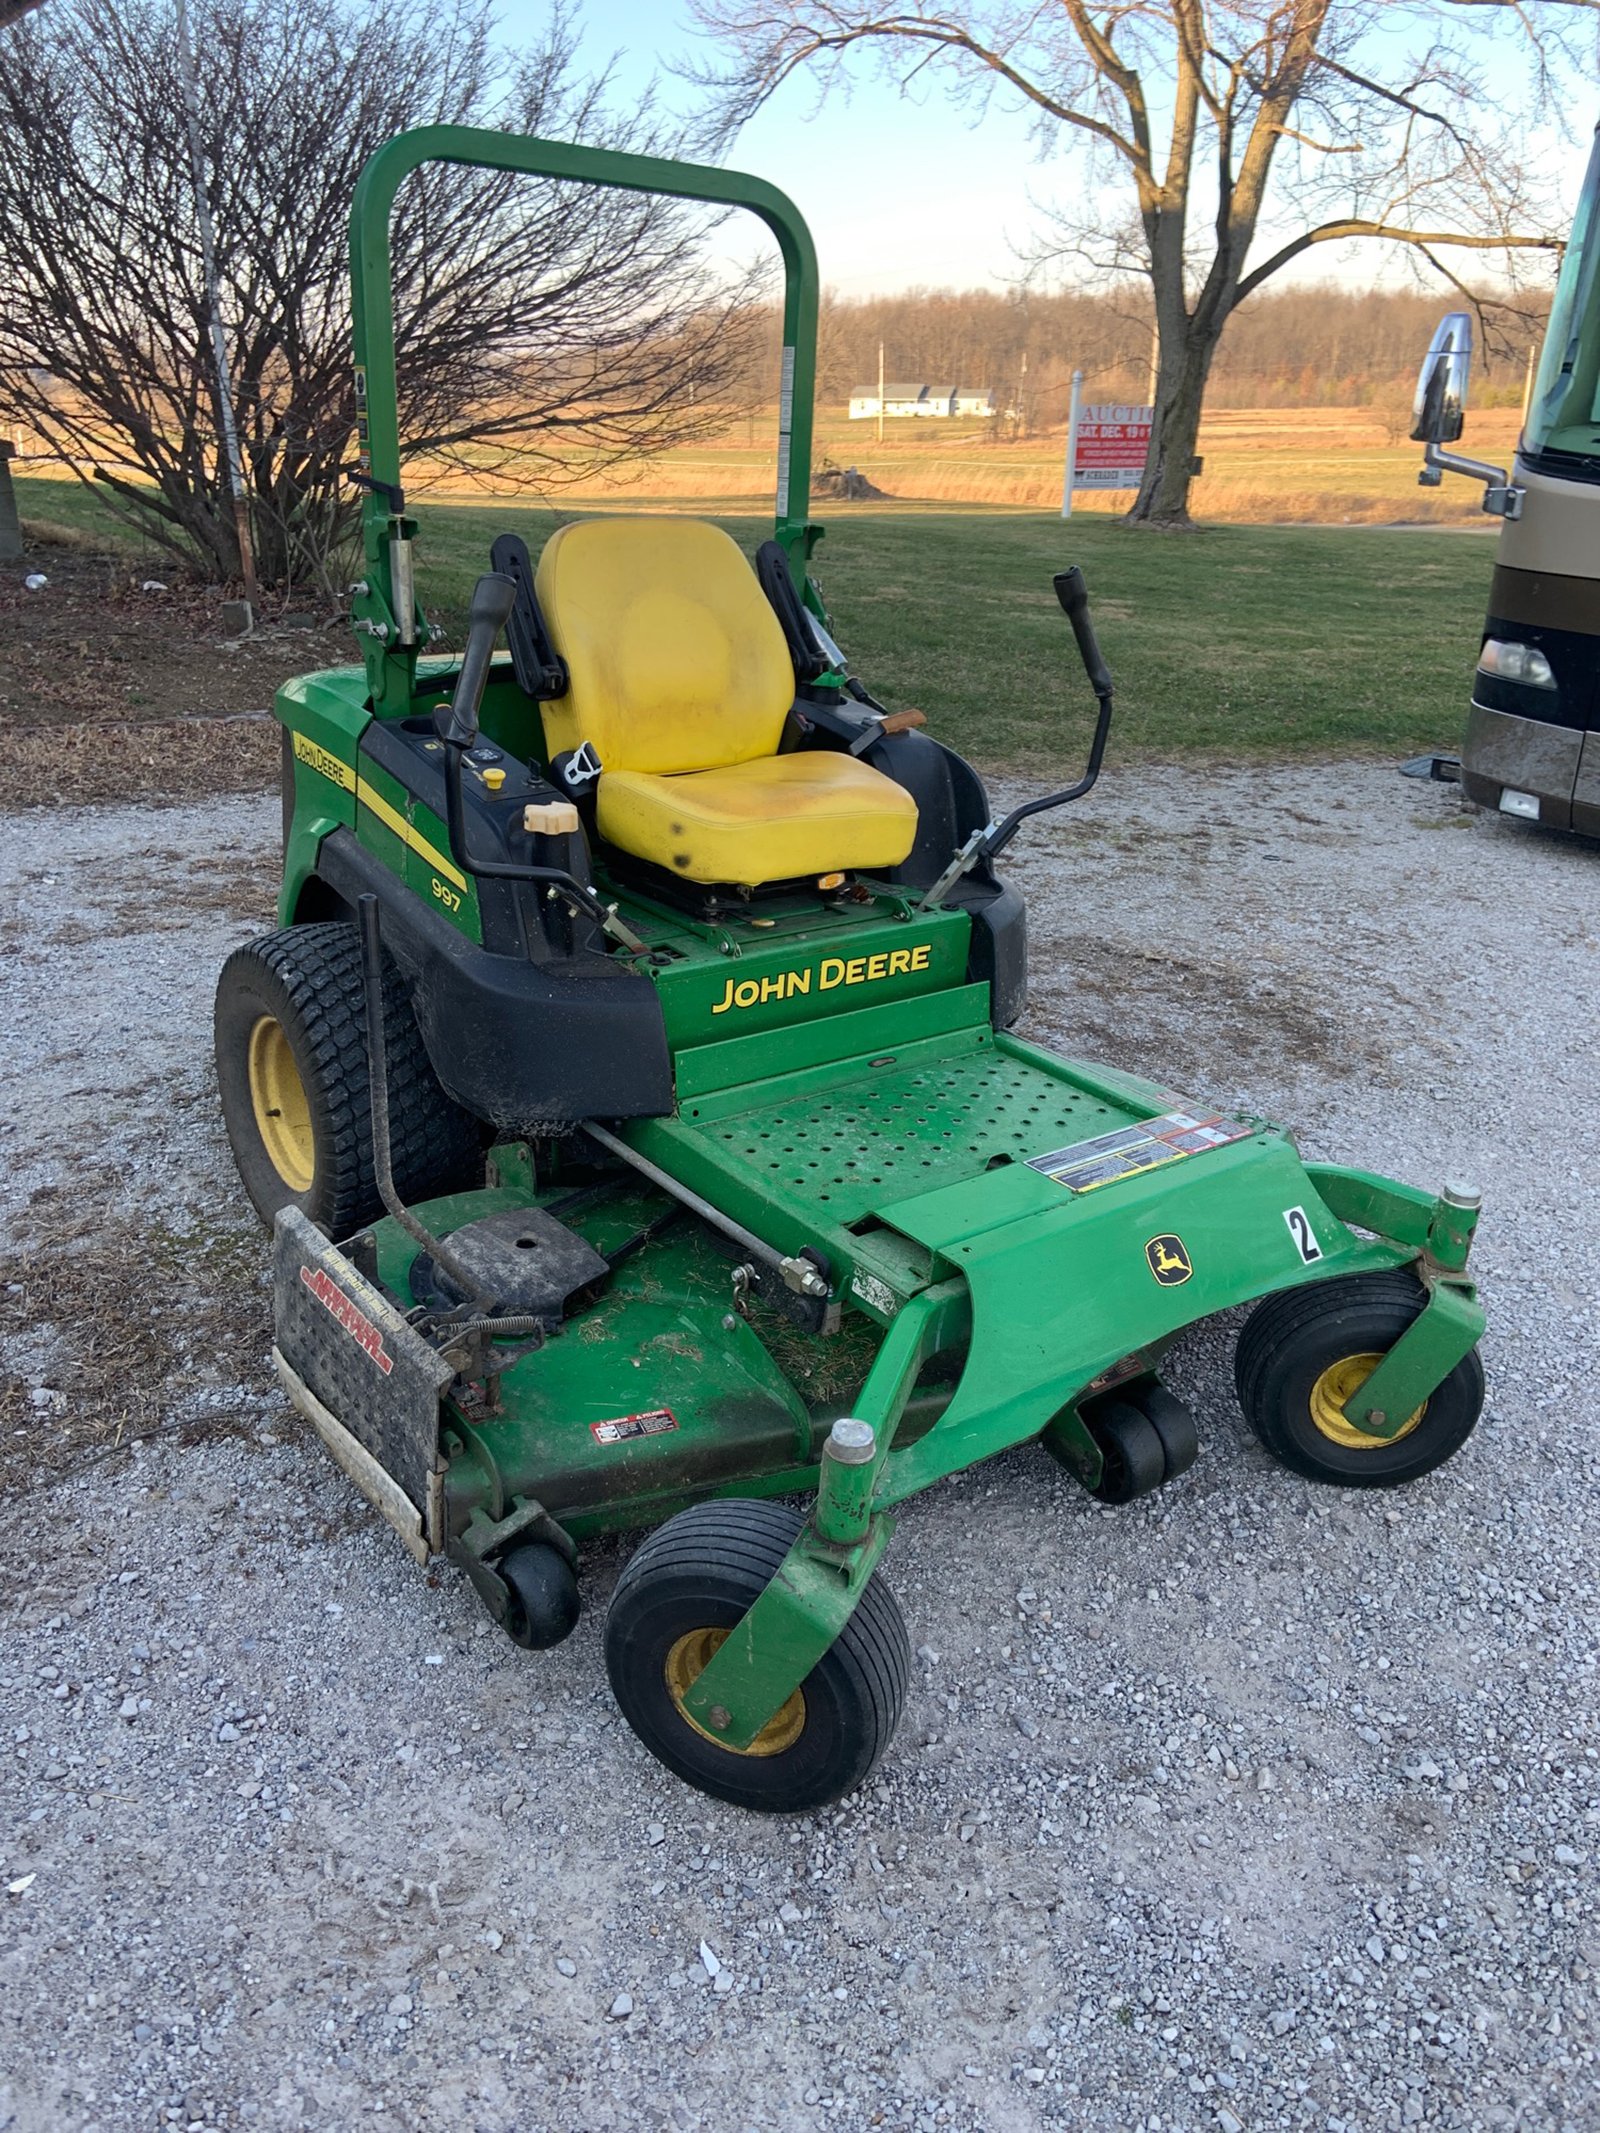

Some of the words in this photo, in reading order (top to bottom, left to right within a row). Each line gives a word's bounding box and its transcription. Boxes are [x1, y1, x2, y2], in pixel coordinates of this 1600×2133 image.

[1100, 426, 1124, 438] DEC.
[297, 739, 317, 766] JOHN
[317, 749, 345, 786] DEERE
[431, 878, 461, 912] 997
[711, 968, 812, 1013] JOHN
[818, 944, 932, 990] DEERE
[1289, 1210, 1320, 1262] 2
